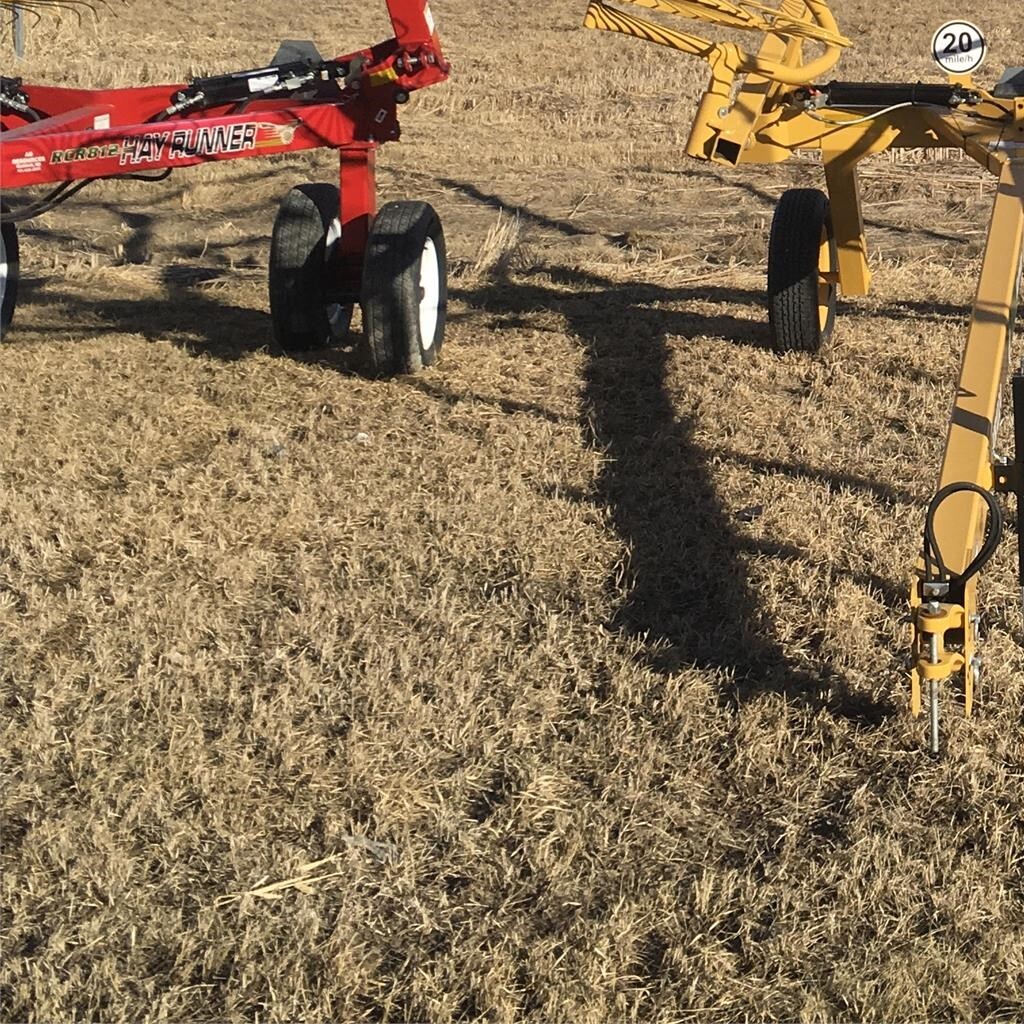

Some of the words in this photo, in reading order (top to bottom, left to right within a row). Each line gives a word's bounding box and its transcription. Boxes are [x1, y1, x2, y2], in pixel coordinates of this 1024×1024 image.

[943, 32, 973, 54] 20
[945, 54, 974, 64] mile/h
[120, 132, 170, 165] HAY
[169, 123, 258, 159] RUNNER
